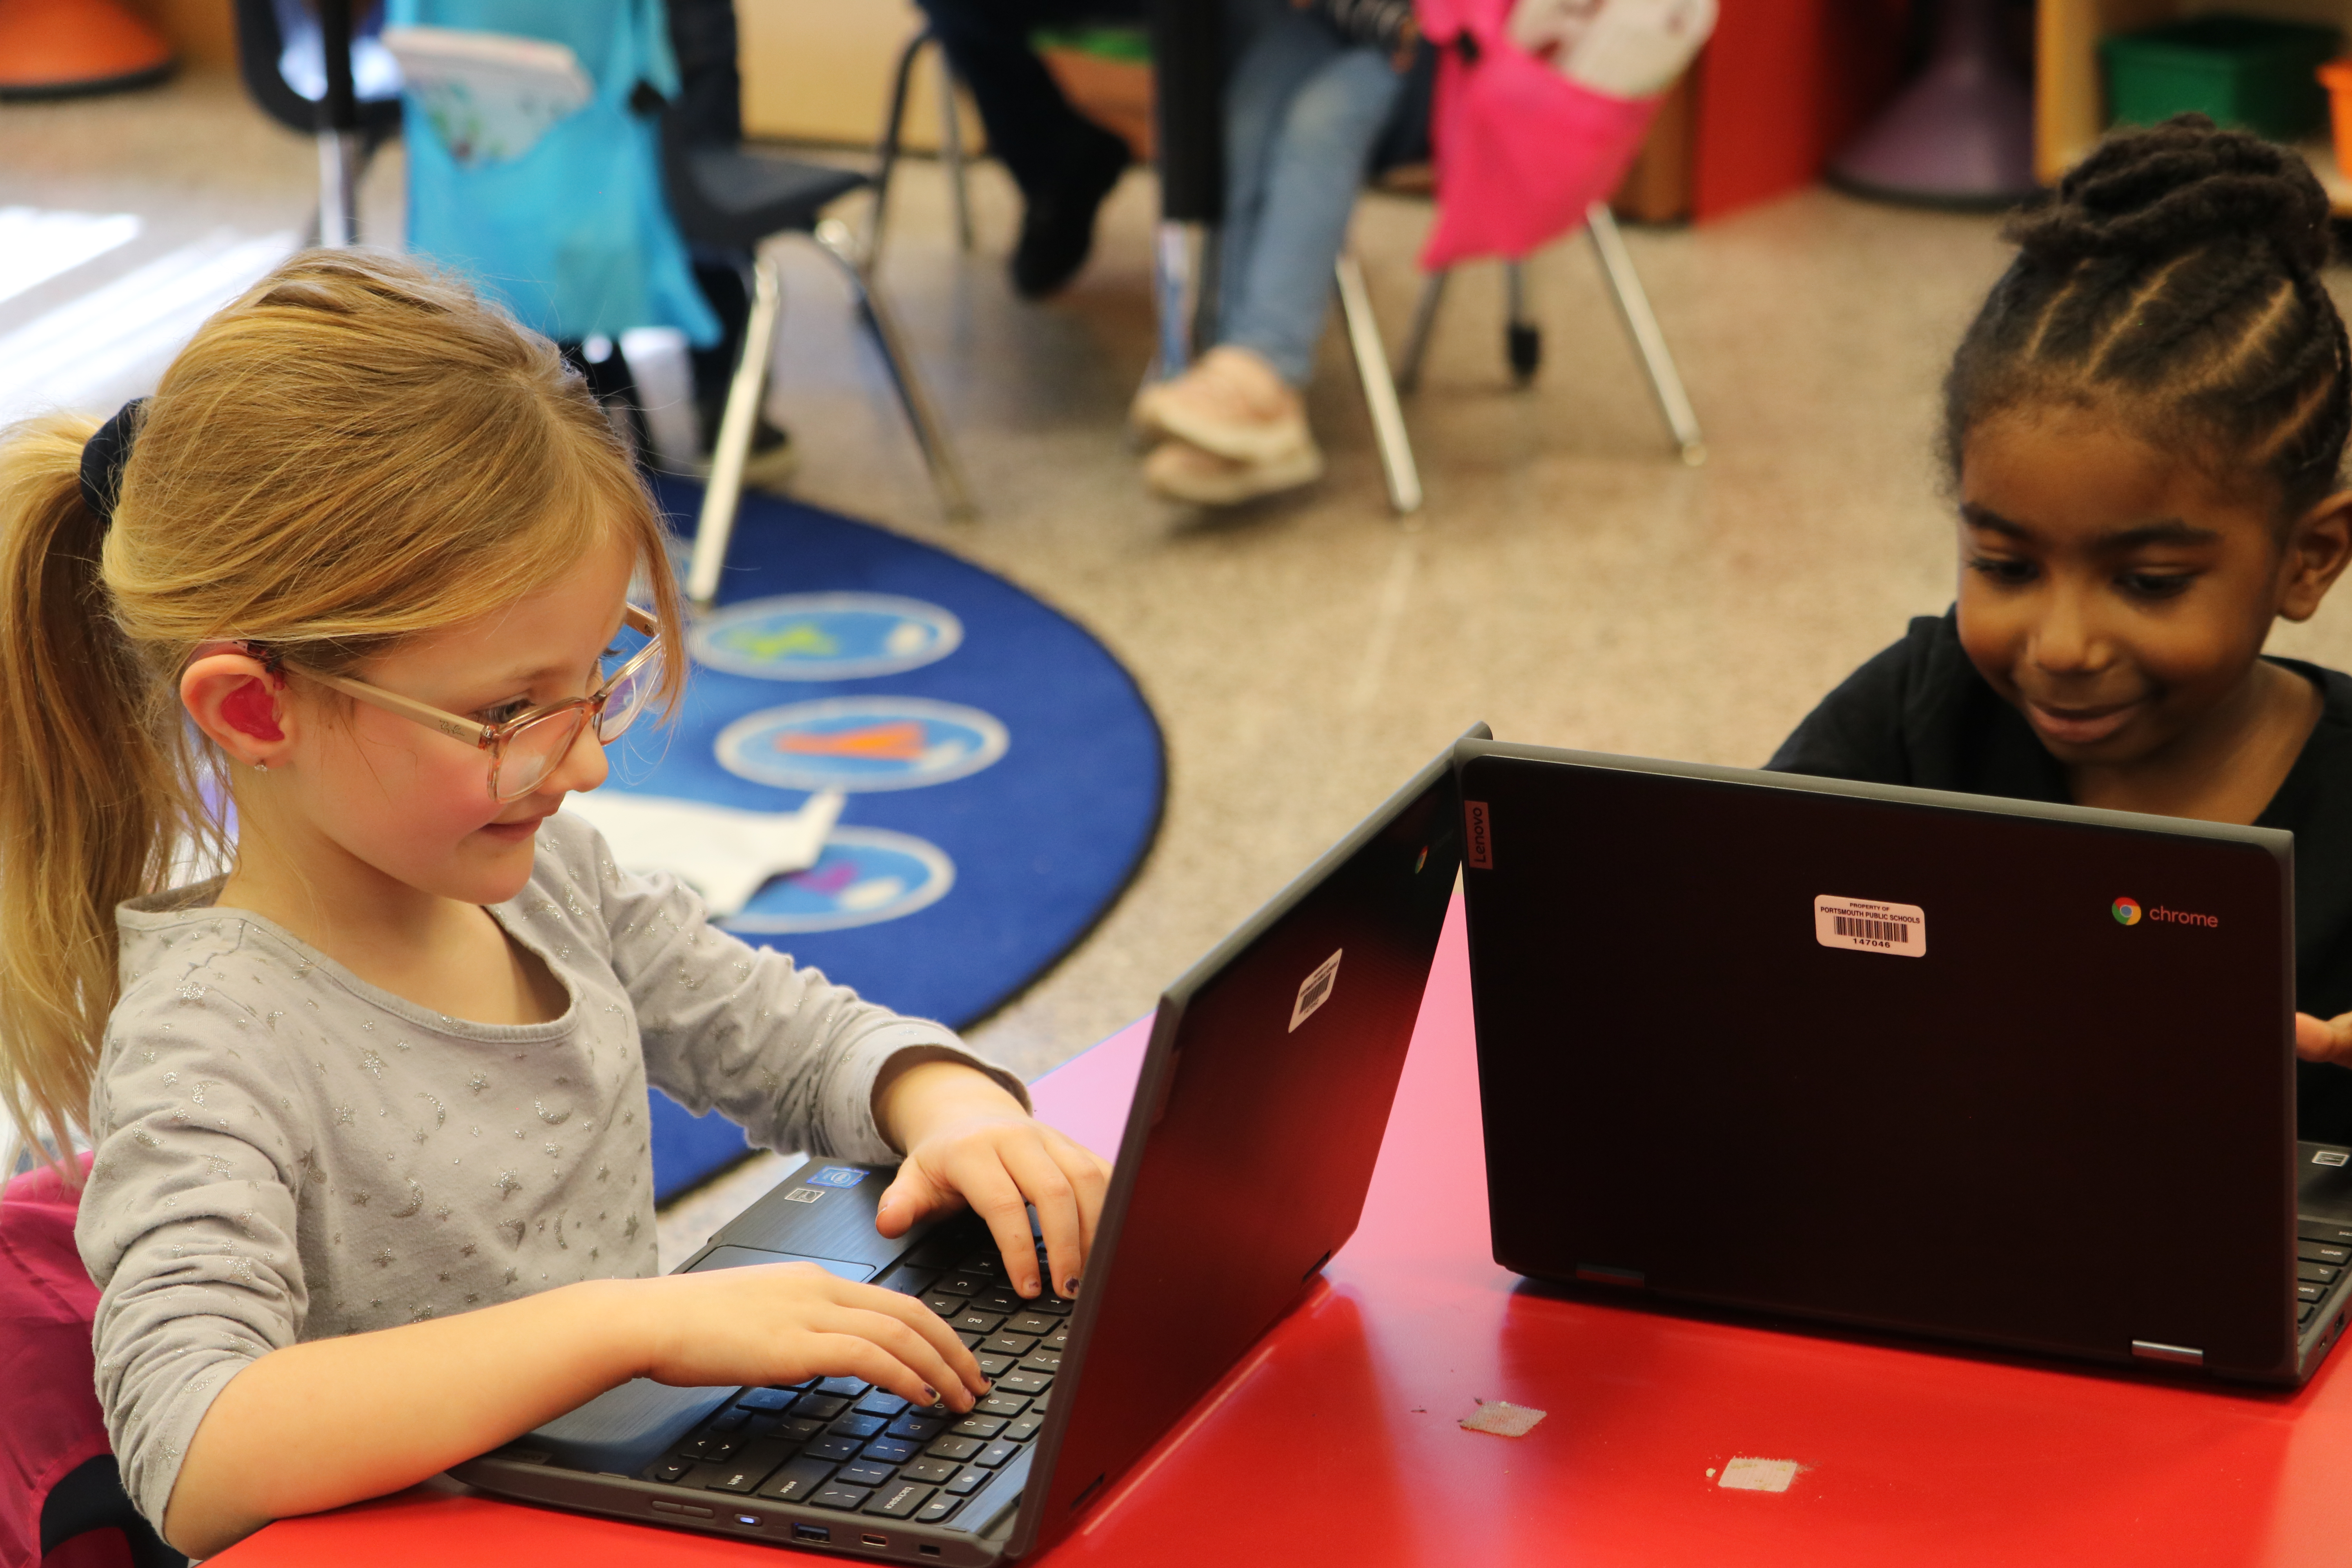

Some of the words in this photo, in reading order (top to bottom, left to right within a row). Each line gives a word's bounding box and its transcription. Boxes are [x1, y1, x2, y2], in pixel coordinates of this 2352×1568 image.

[1473, 807, 1486, 863] Lenovo
[1820, 907, 1864, 917] PORTSMOUTH
[1890, 915, 1920, 924] SCHOOLS
[2149, 906, 2218, 927] chrome
[1853, 938, 1891, 948] 147046
[727, 1475, 743, 1485] shift
[780, 1481, 797, 1493] enter
[884, 1487, 915, 1509] backspace
